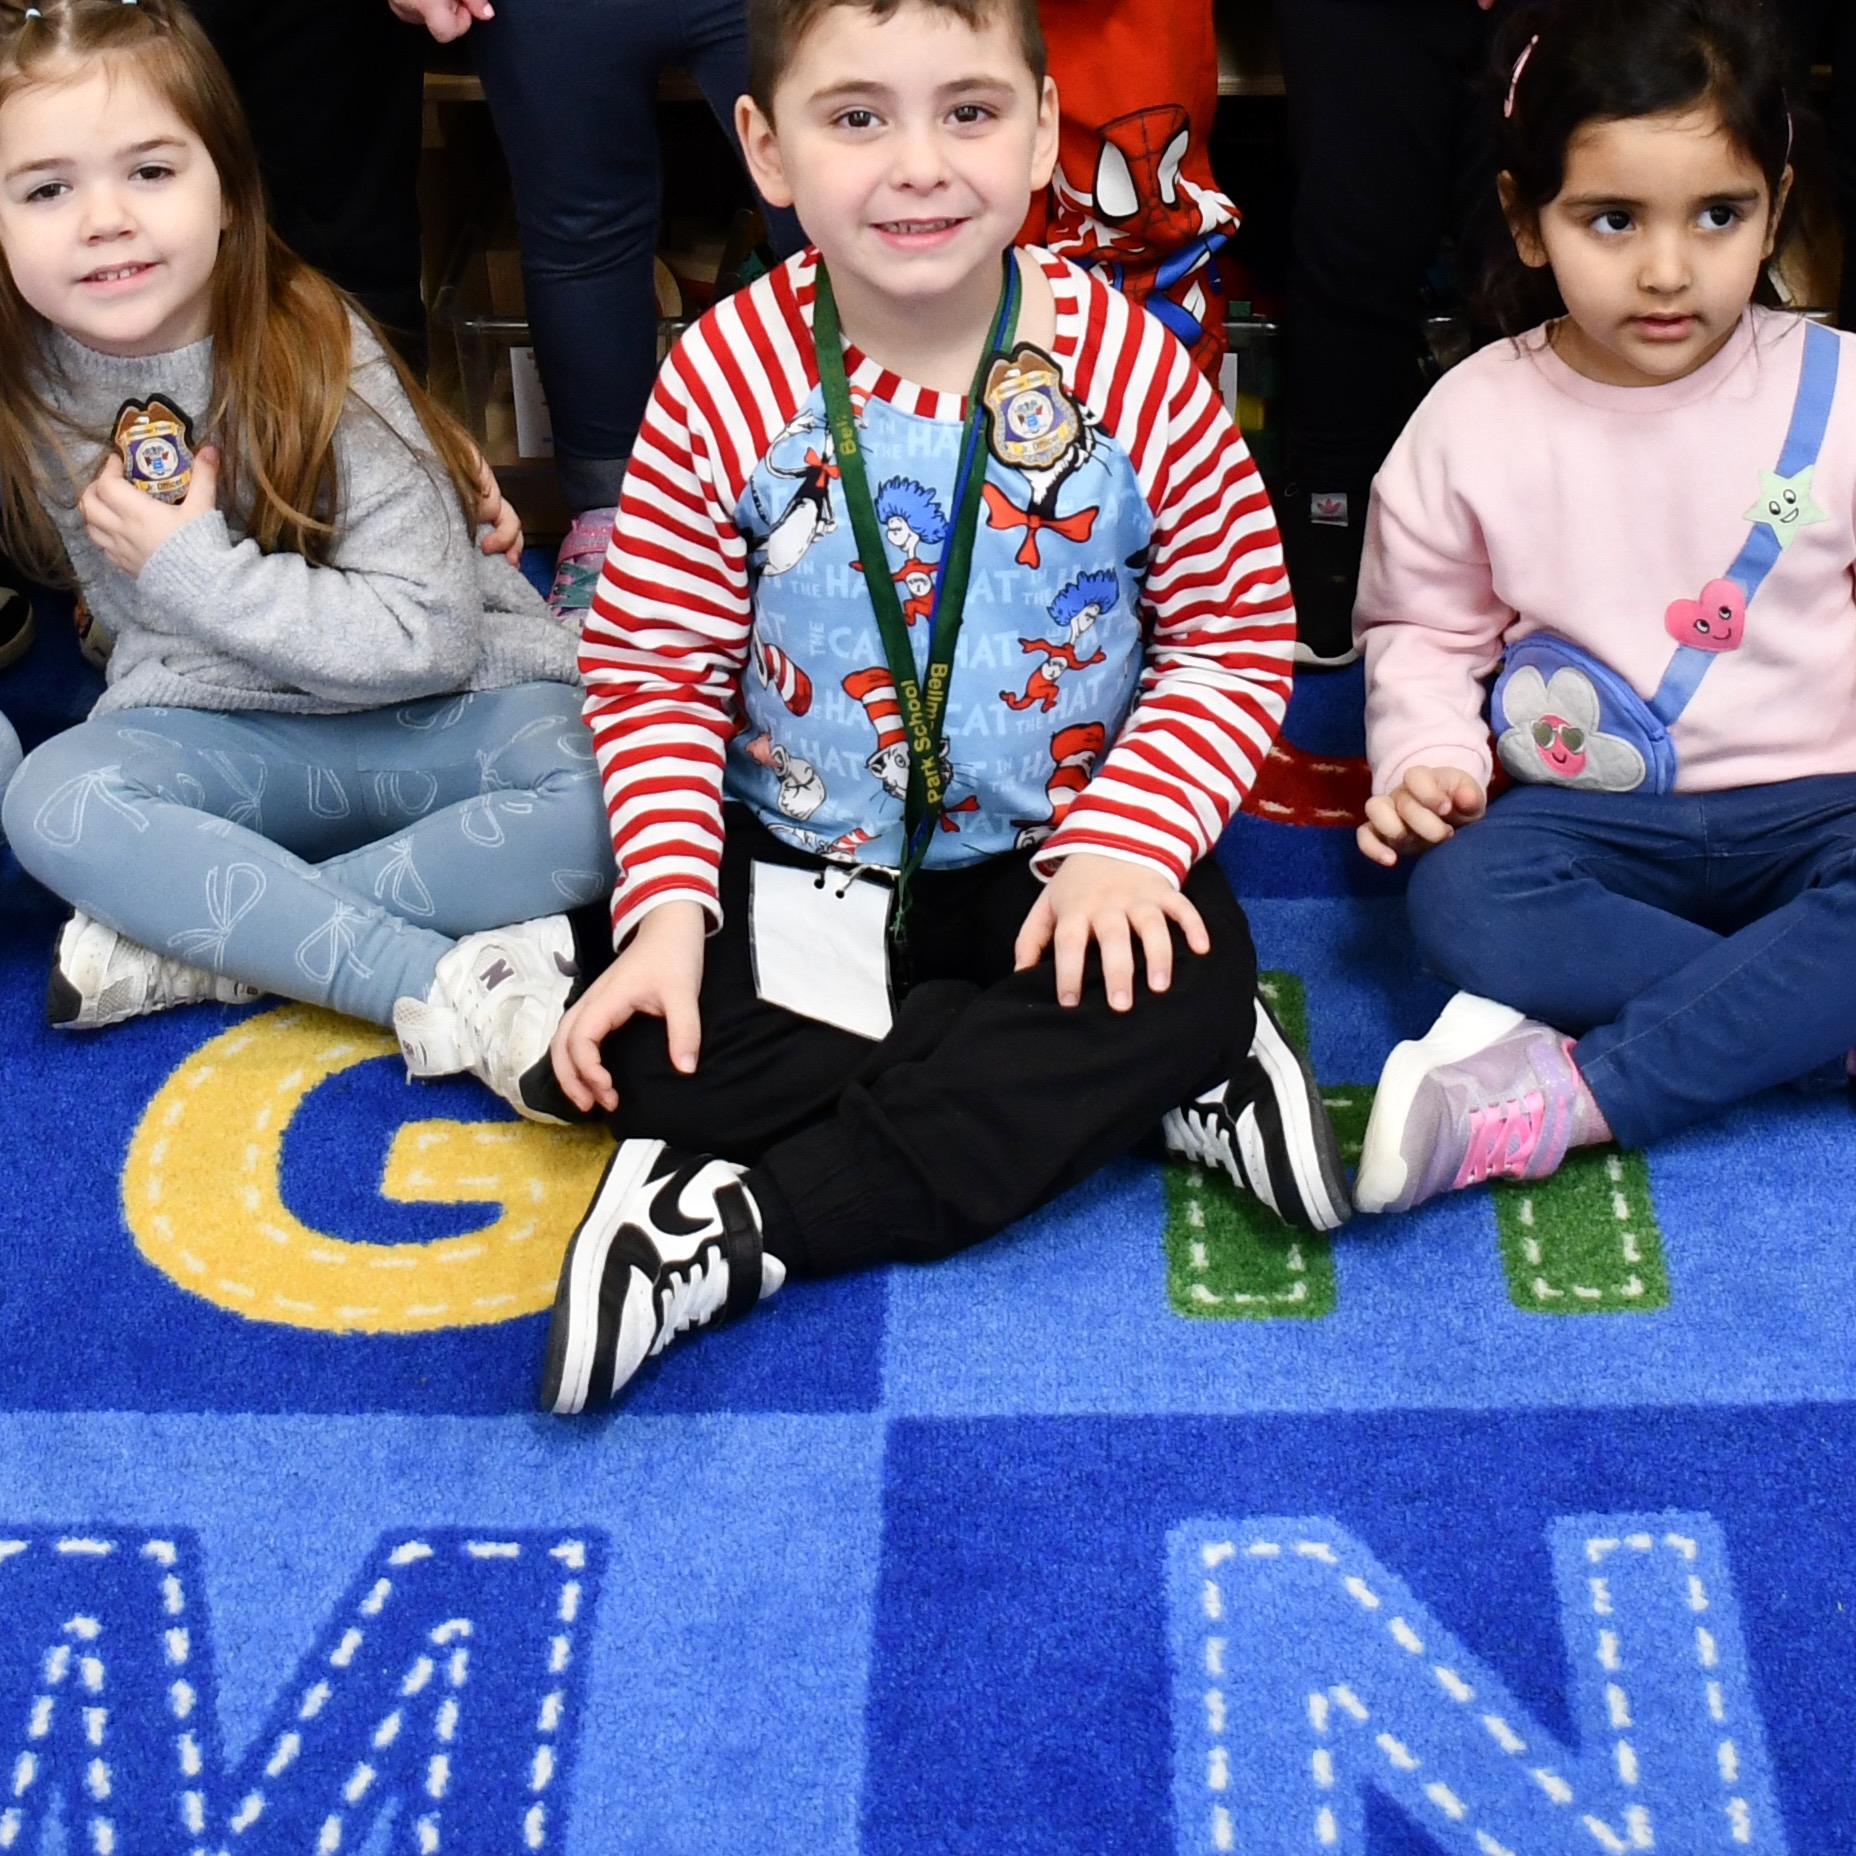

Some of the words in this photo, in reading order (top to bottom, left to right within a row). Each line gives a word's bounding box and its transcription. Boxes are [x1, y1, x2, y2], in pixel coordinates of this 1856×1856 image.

[900, 679, 932, 753] School
[920, 755, 942, 805] Park
[120, 1001, 619, 1335] G
[1162, 1508, 1692, 1856] N
